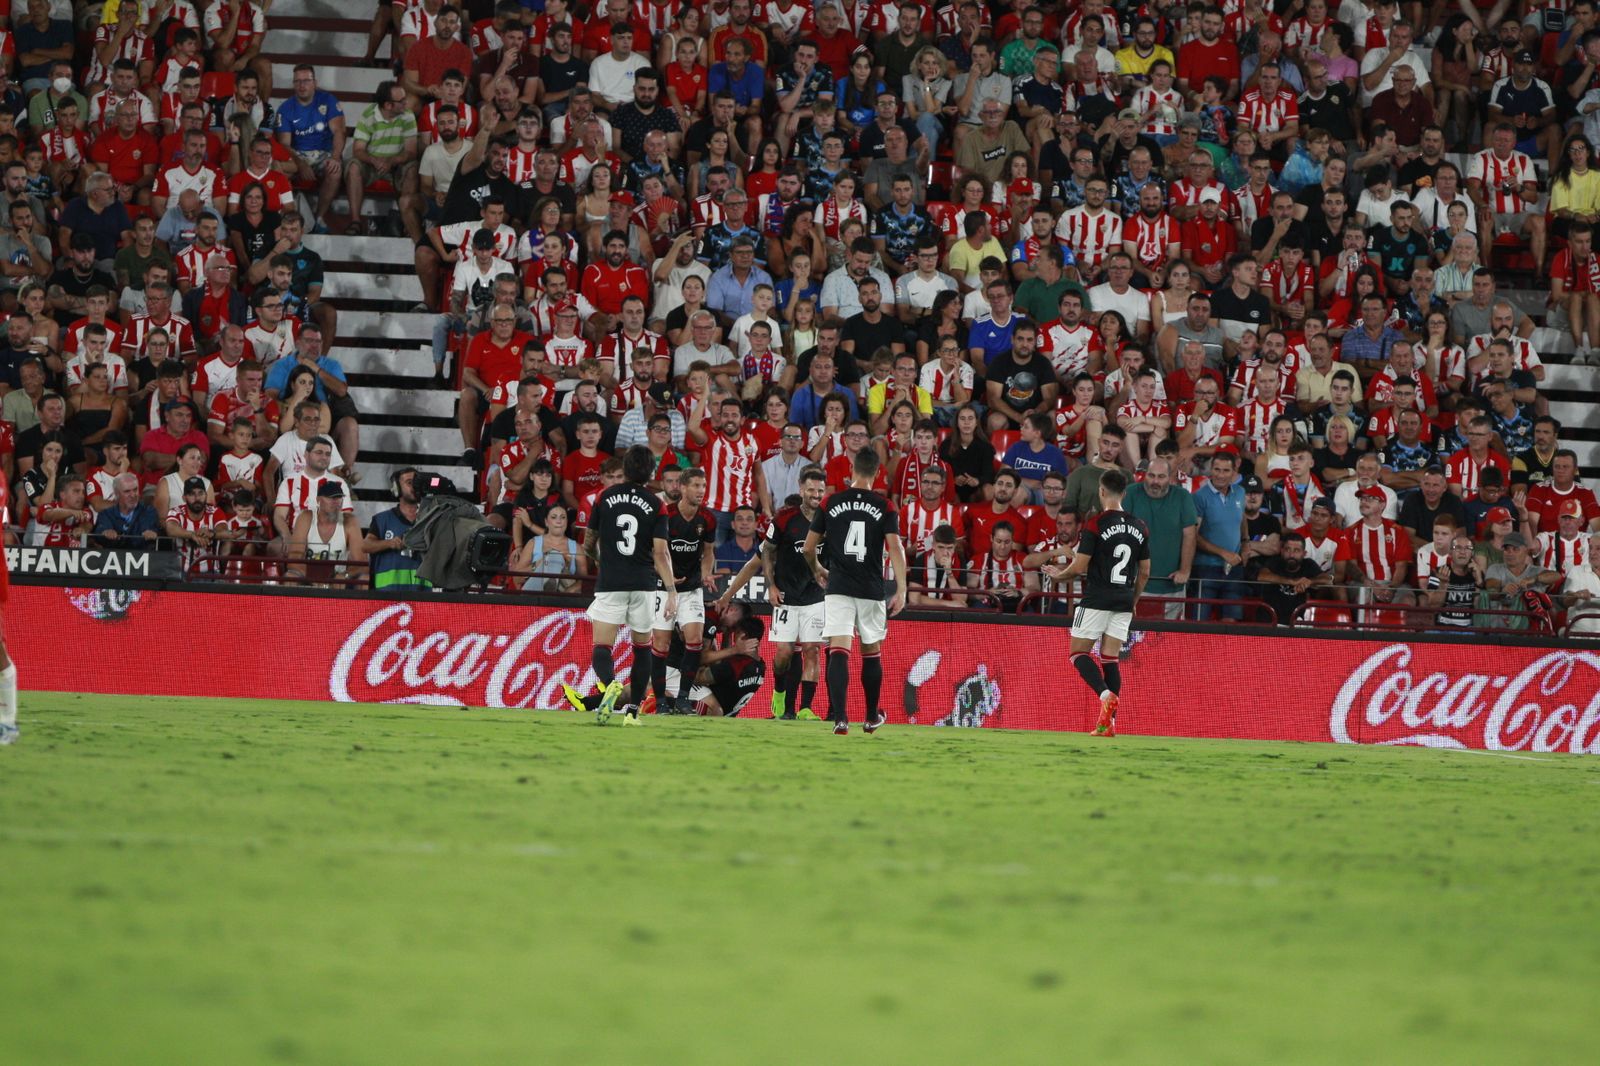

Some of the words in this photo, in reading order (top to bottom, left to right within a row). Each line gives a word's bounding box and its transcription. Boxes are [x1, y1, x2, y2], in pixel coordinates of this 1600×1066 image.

[605, 493, 630, 509] JUAN
[630, 495, 654, 515] CRUZ
[828, 501, 852, 518] UNAI
[853, 501, 883, 521] GARCÍA
[616, 513, 639, 556] 3
[844, 520, 867, 563] 4
[1100, 523, 1126, 541] NACHO
[1127, 524, 1145, 545] VIDAL
[3, 547, 149, 577] #FANCAM
[1110, 543, 1132, 585] 2
[774, 608, 788, 624] 14
